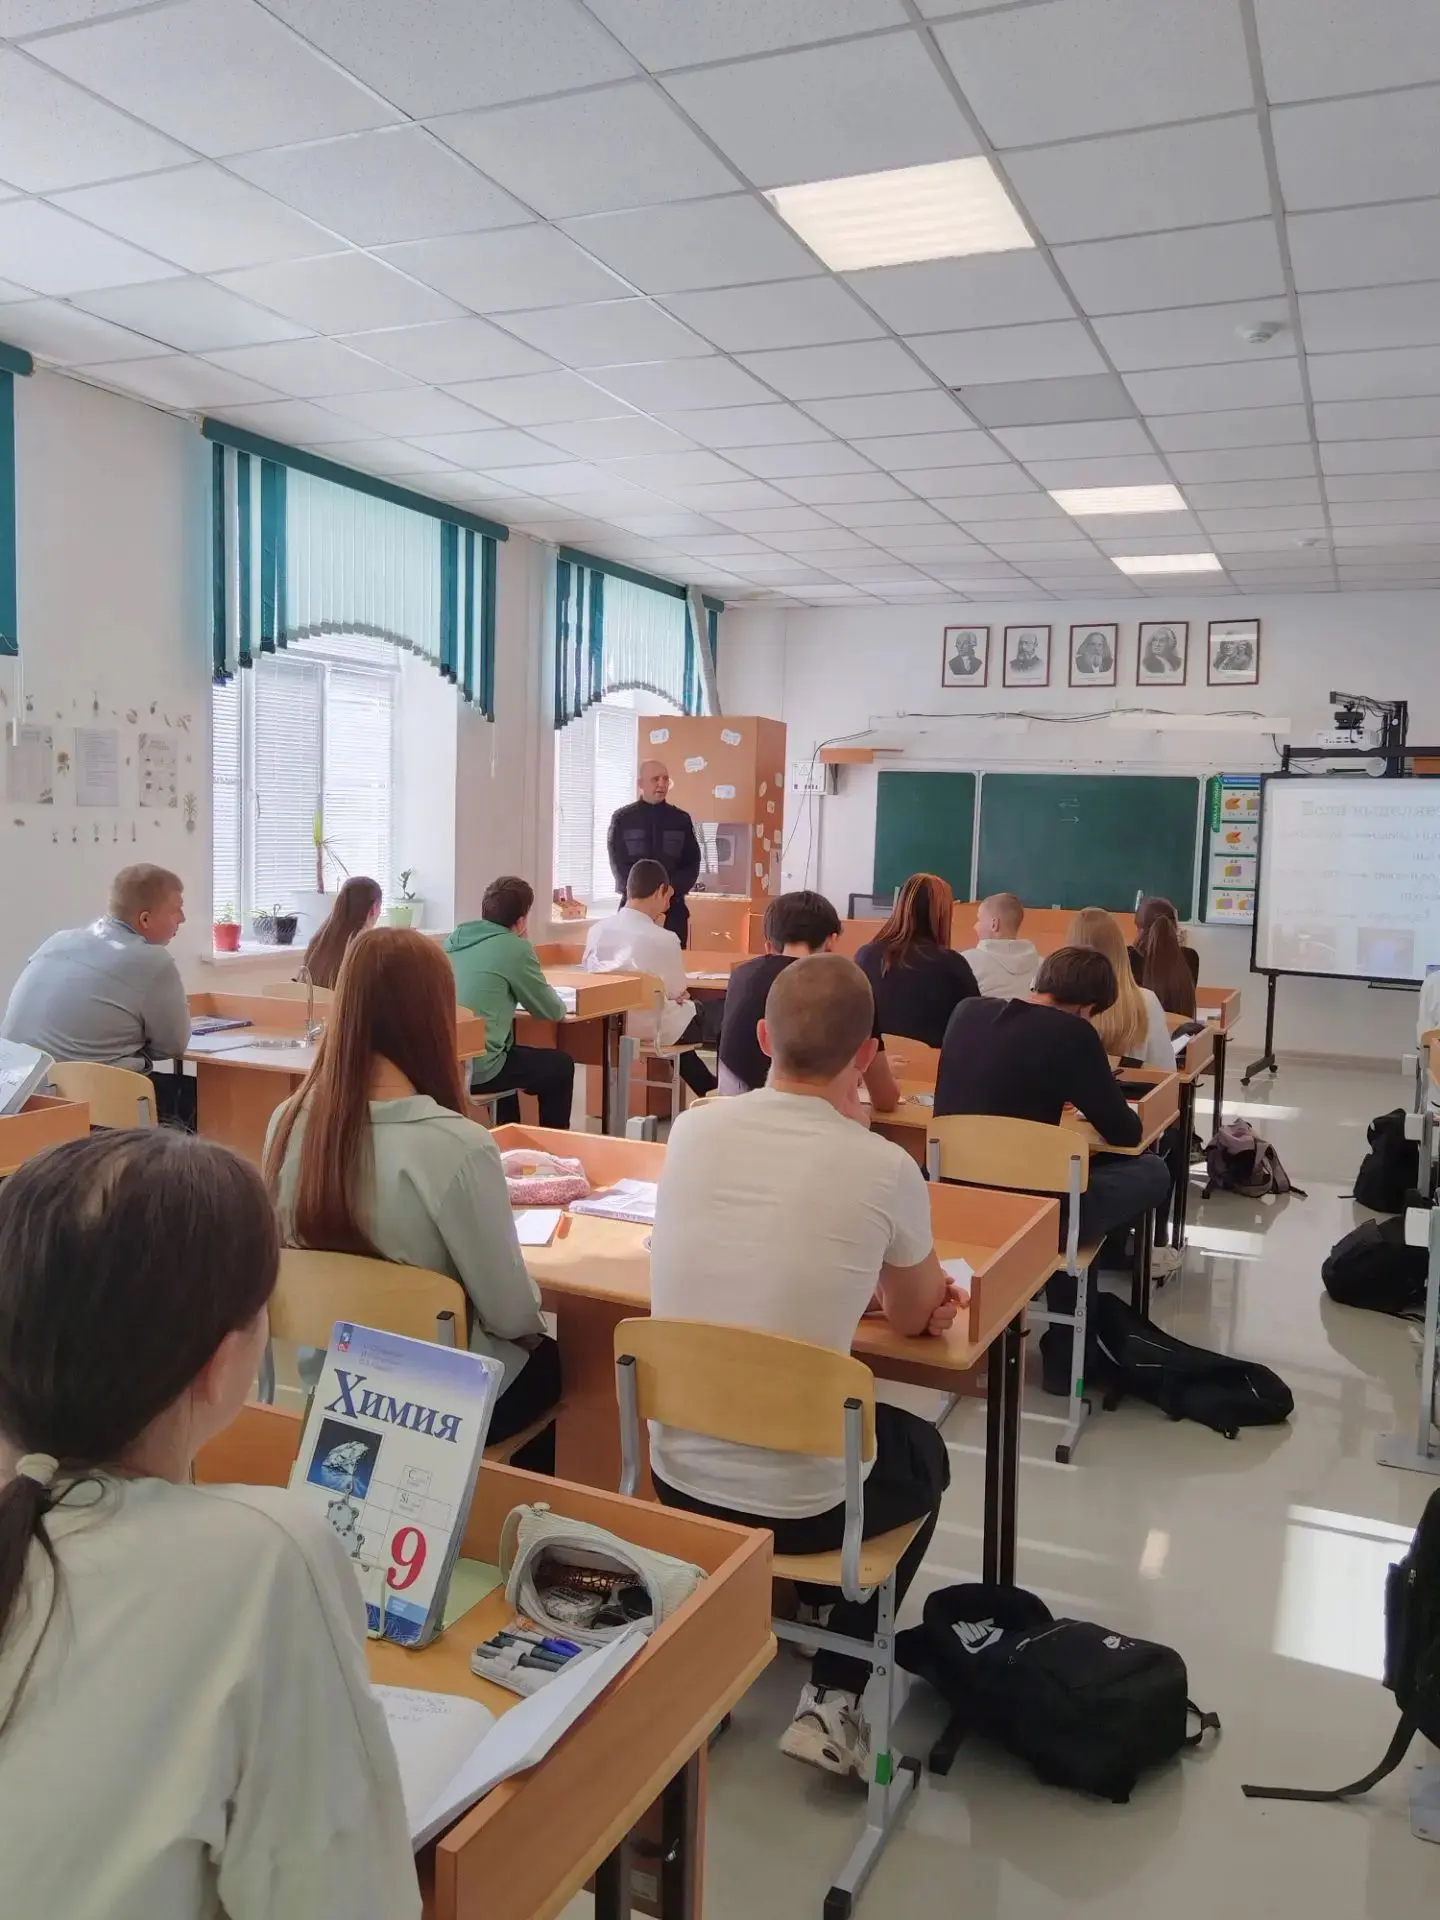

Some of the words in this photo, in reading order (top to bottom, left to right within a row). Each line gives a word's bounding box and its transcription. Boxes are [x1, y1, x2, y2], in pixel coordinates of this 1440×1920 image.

[324, 1368, 463, 1443] Химия
[399, 1492, 410, 1505] Si
[387, 1526, 427, 1590] 9
